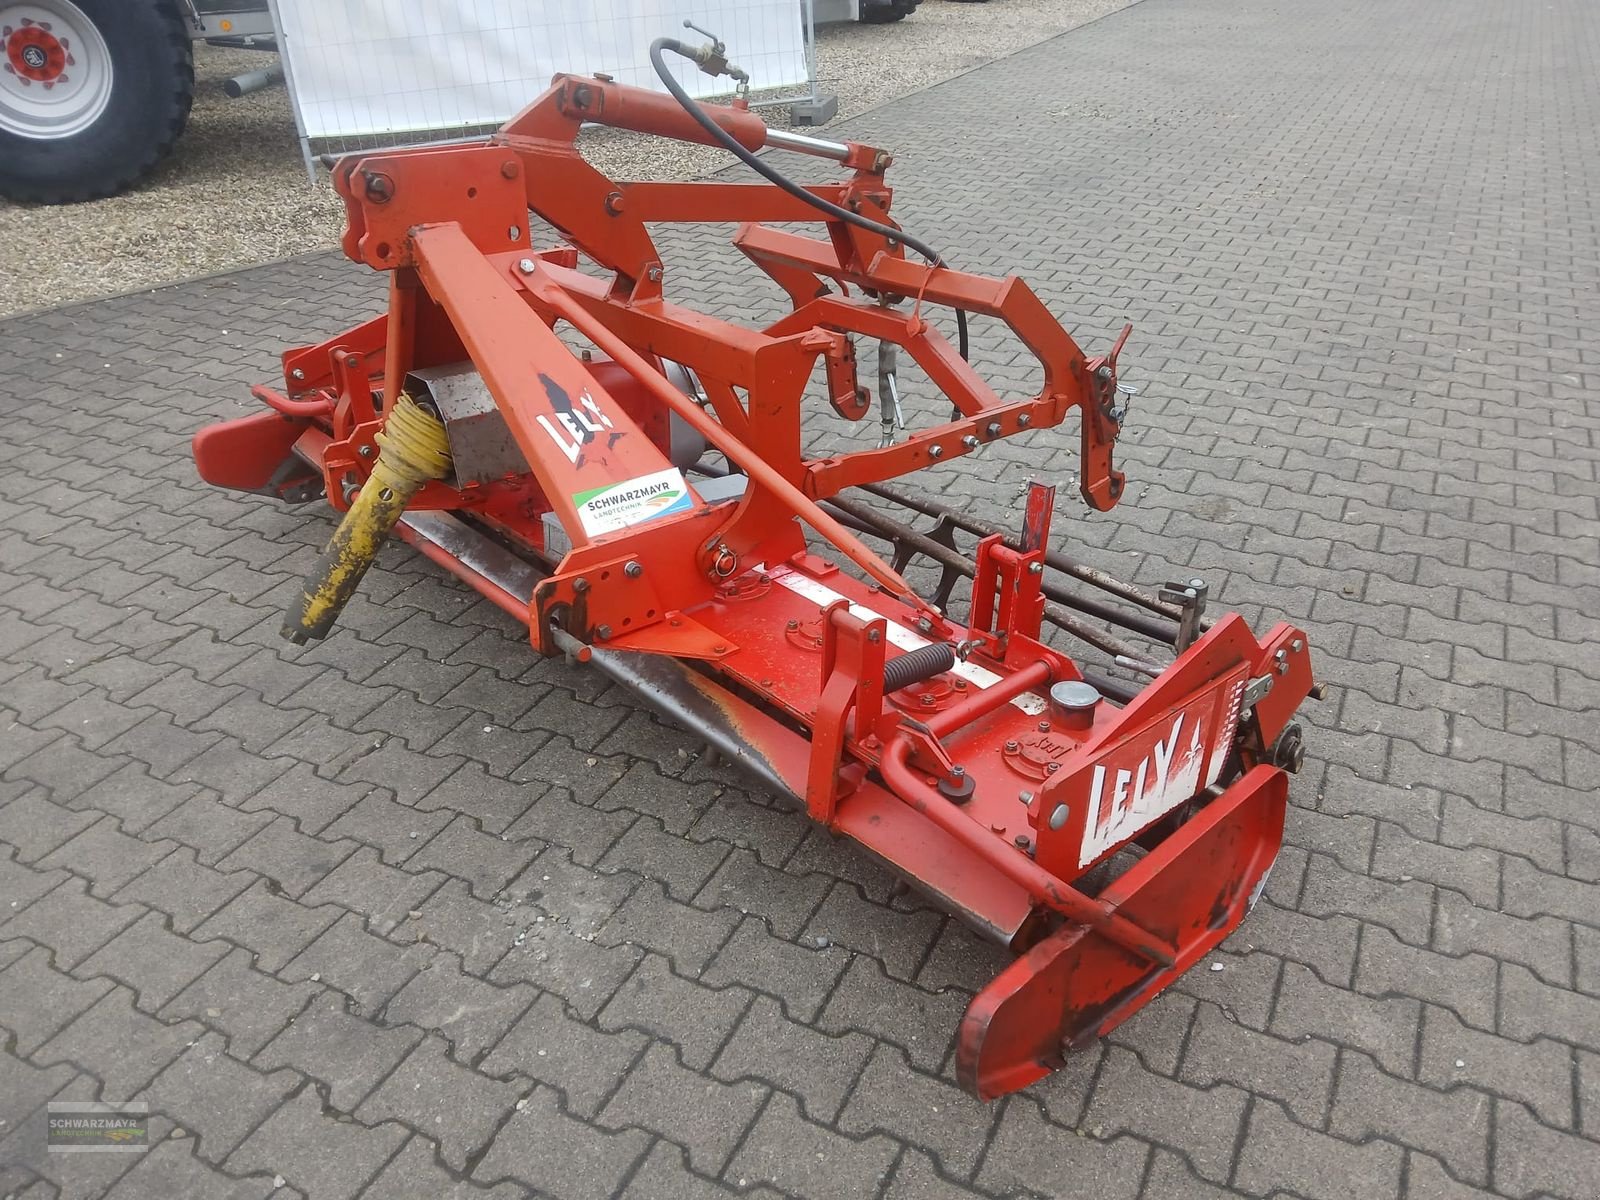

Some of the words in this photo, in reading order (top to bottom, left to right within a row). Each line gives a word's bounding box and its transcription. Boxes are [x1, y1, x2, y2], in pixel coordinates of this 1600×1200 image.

[536, 387, 614, 464] LELY
[587, 481, 671, 512] SCHWARZMAYR
[593, 502, 643, 519] LANDTECHNIK
[1084, 711, 1186, 843] LELY
